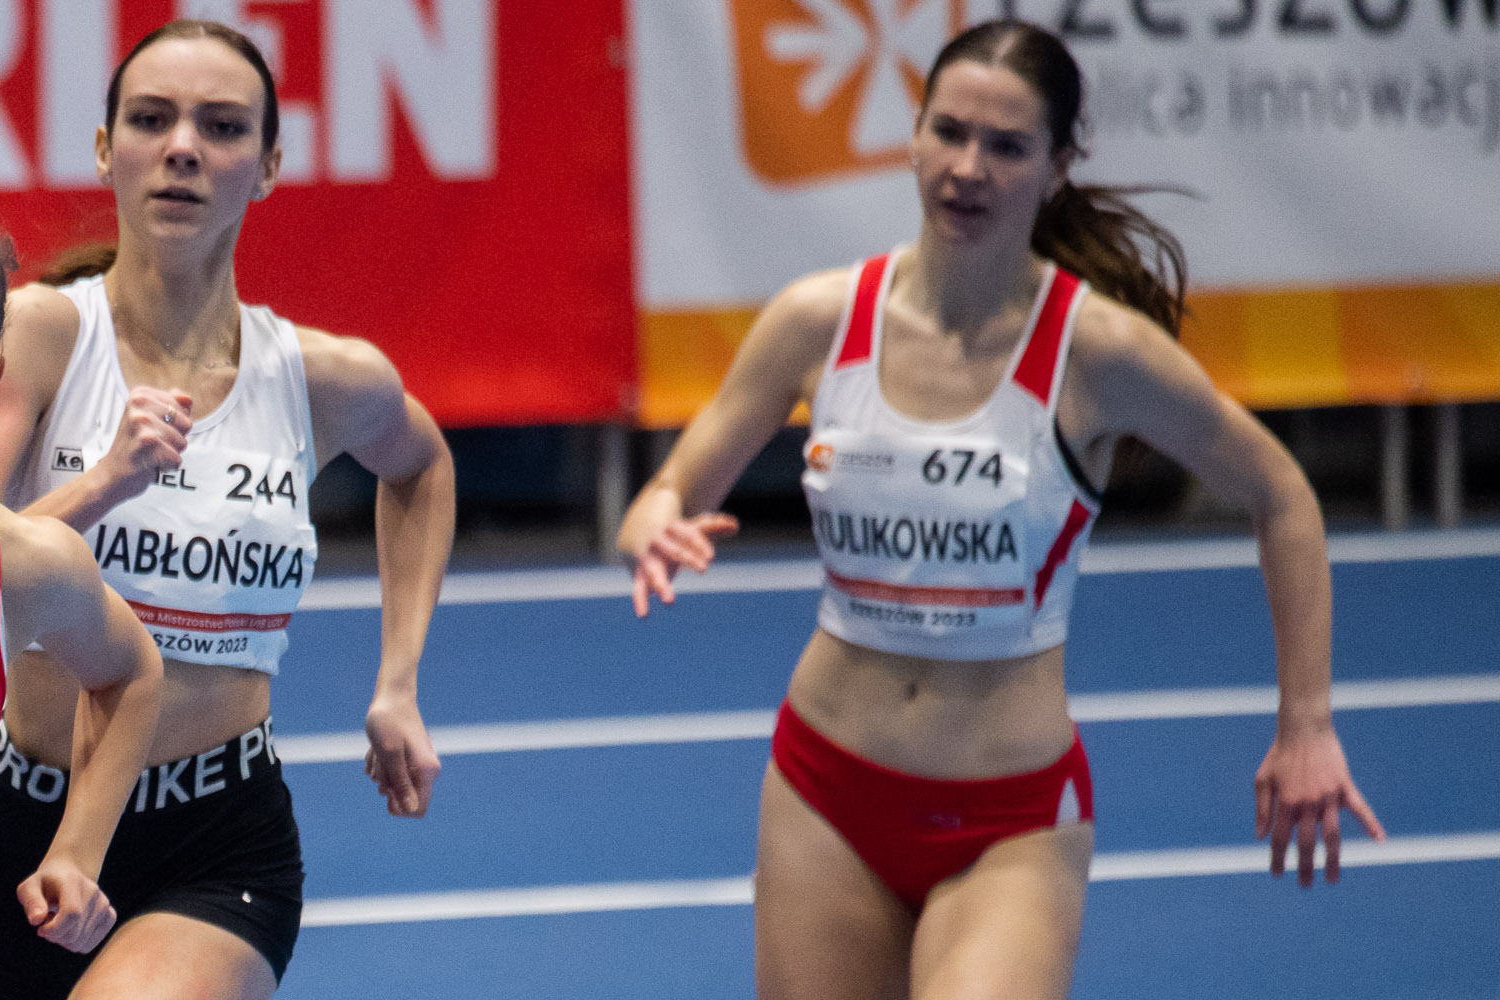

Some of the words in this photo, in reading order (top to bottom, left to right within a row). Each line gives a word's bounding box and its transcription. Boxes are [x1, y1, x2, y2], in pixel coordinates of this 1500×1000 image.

[225, 463, 297, 509] 244
[922, 449, 1003, 488] 674
[153, 633, 214, 654] SZÓW
[215, 636, 249, 655] 2023
[134, 744, 227, 814] IKE
[239, 716, 277, 781] PR
